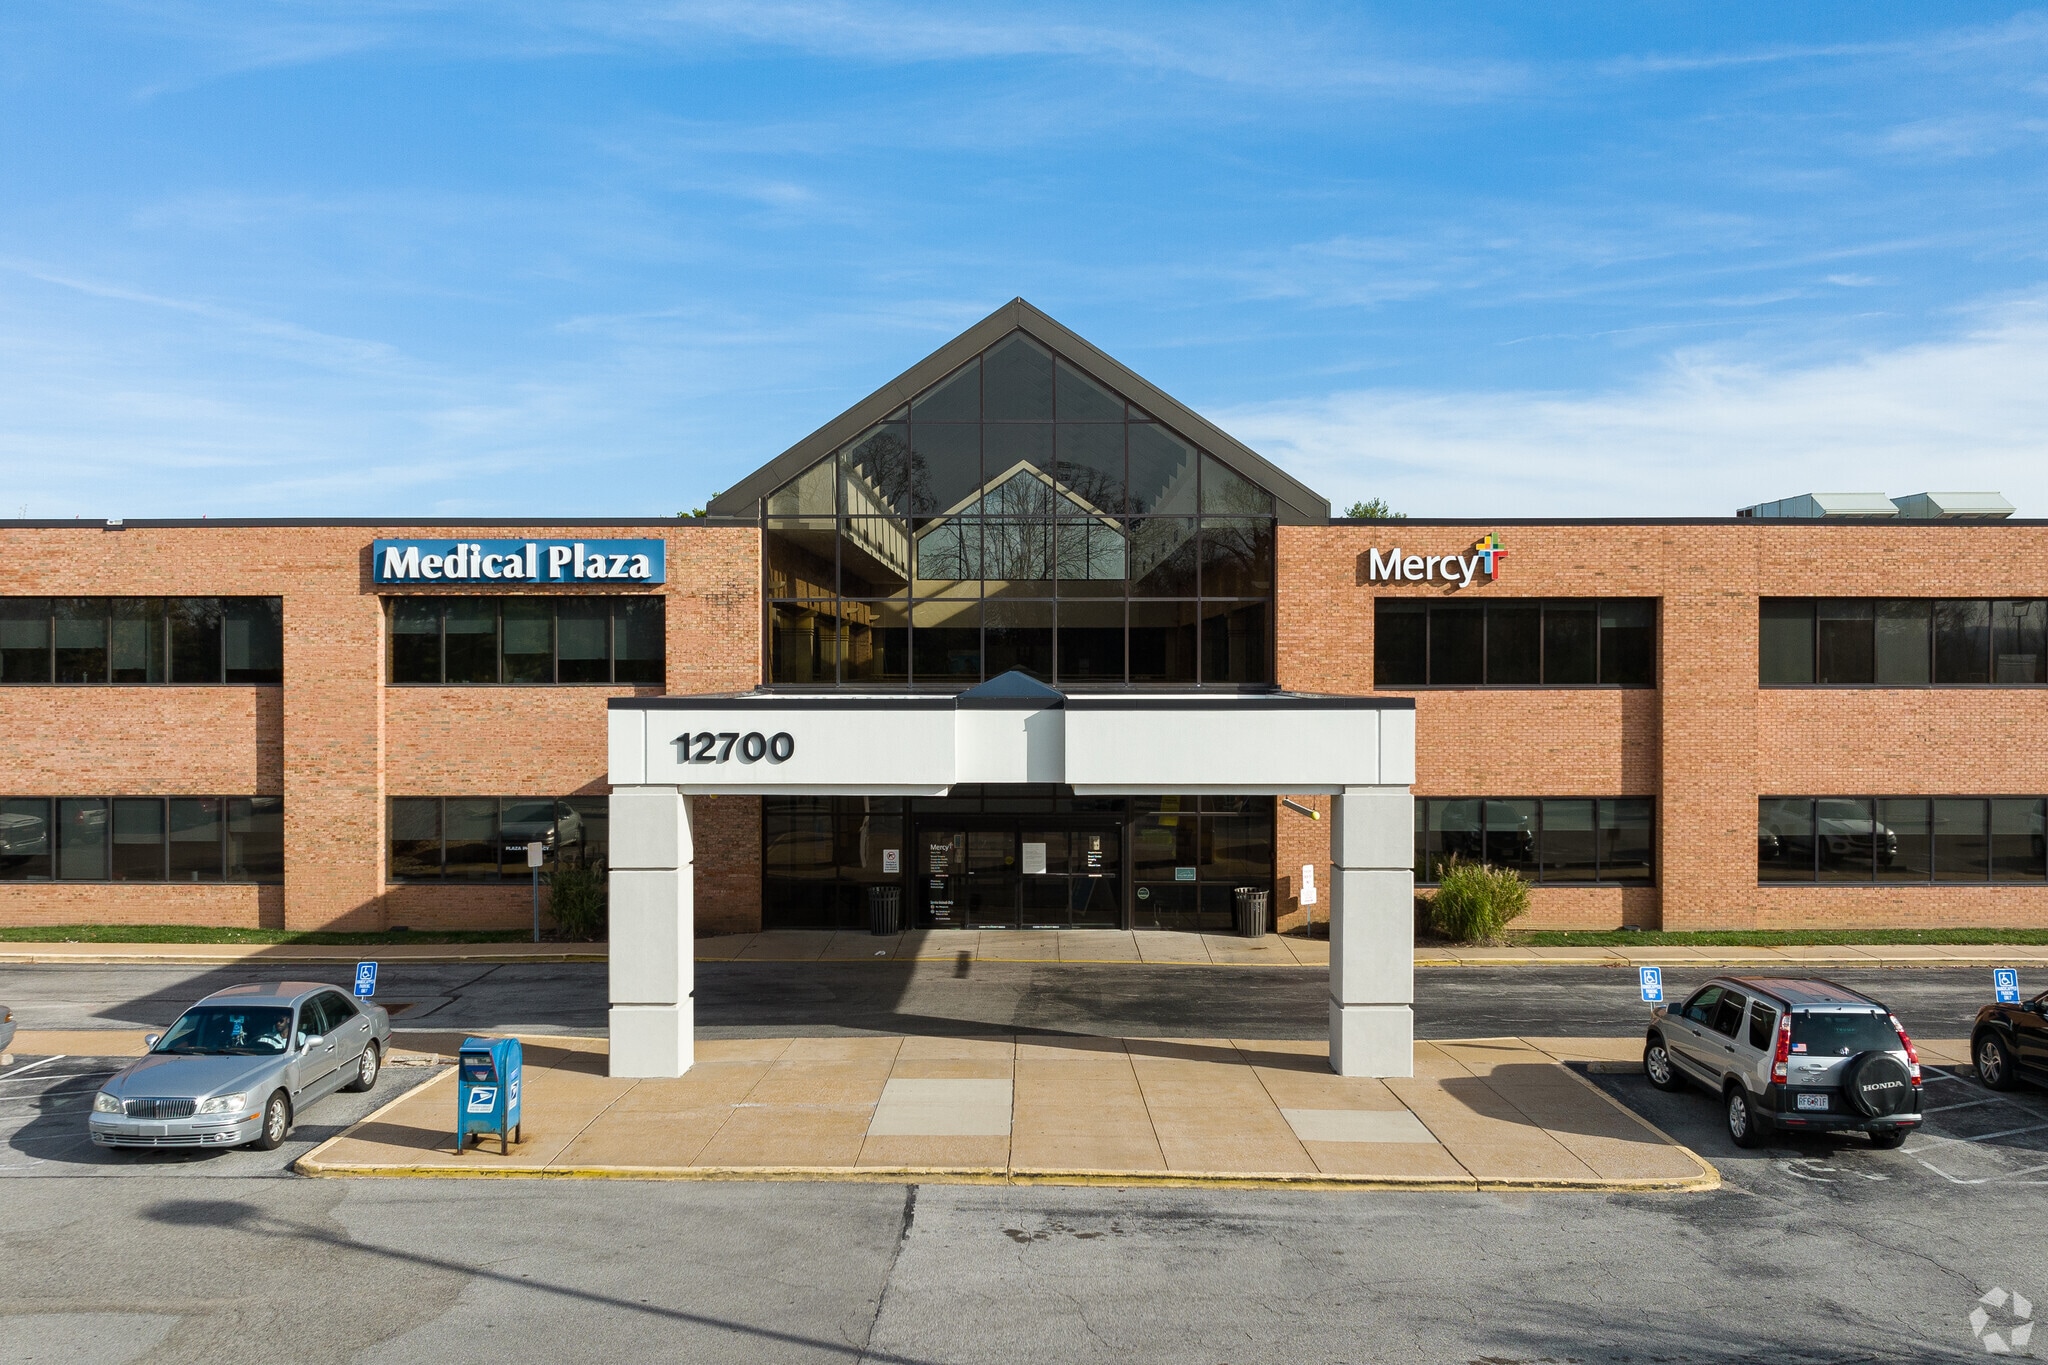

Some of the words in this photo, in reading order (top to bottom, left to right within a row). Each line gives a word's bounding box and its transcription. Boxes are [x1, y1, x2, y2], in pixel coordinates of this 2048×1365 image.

[382, 543, 537, 579] Medical
[549, 543, 652, 579] Plaza
[1369, 547, 1479, 588] Mercy
[671, 731, 795, 764] 12700
[930, 844, 949, 852] Mercy
[1862, 1080, 1904, 1092] HONDA
